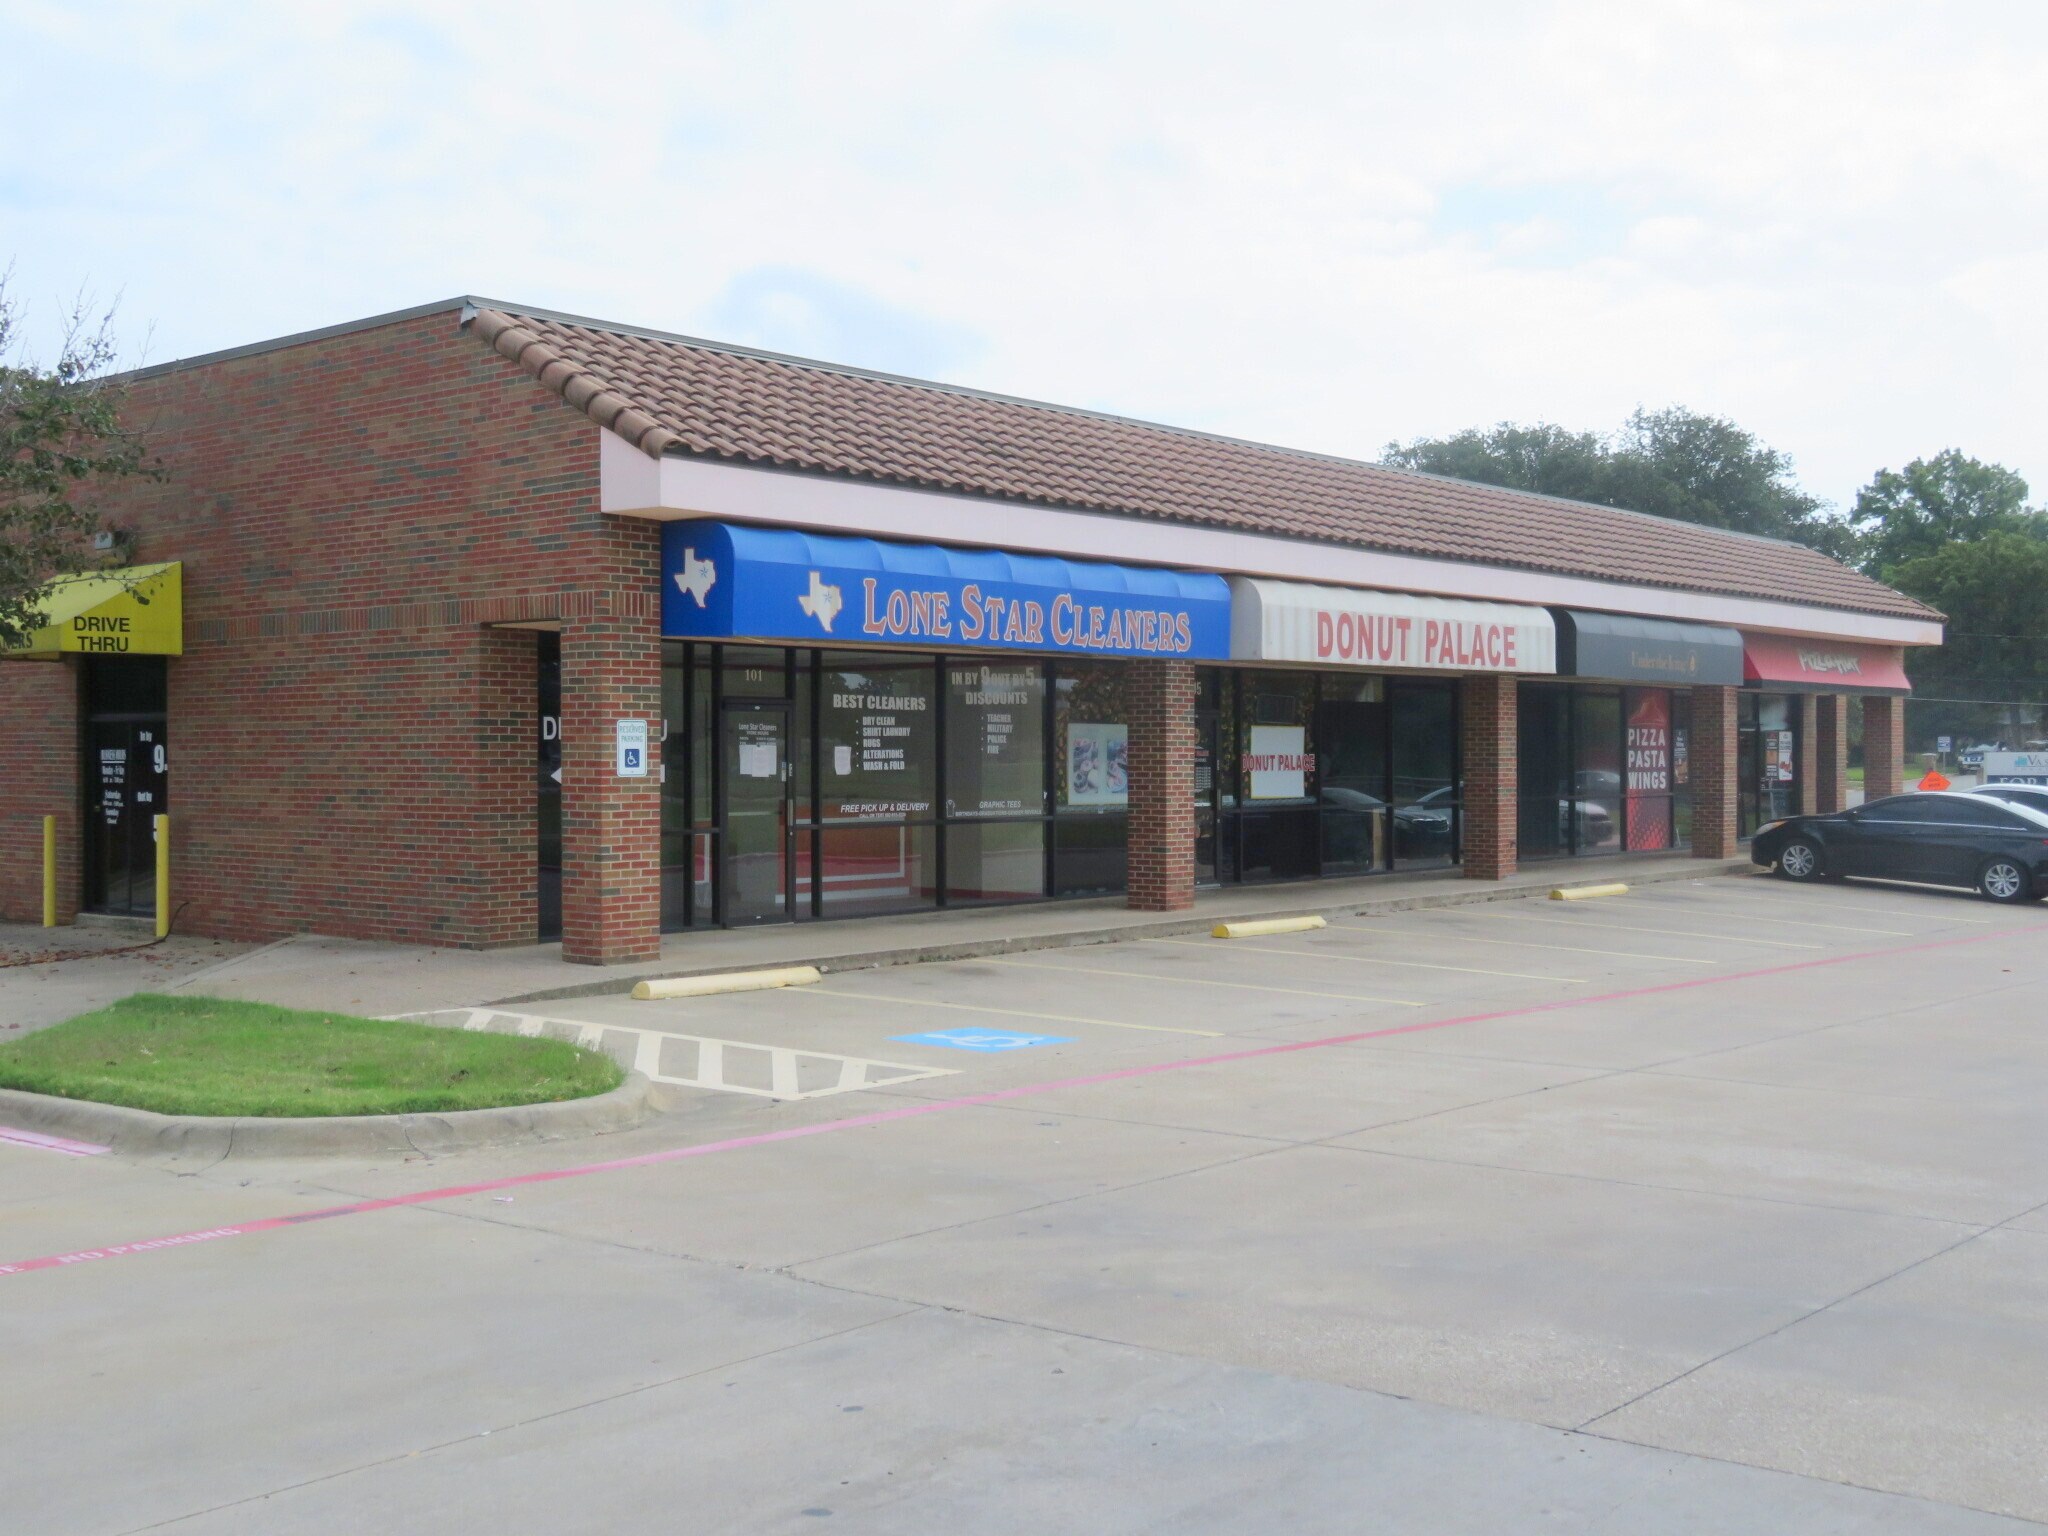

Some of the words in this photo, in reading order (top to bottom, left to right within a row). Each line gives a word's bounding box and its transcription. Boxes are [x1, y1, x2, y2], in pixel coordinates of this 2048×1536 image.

[74, 616, 130, 632] DRIVE
[77, 636, 129, 652] THRU
[1317, 611, 1411, 662] DONUT
[1425, 620, 1517, 667] PALACE
[745, 669, 762, 681] 101
[952, 672, 962, 685] IN
[965, 672, 978, 685] BY
[833, 694, 864, 709] BEST
[867, 695, 926, 711] CLEANERS
[965, 692, 1028, 705] DISCOUNTS
[876, 716, 896, 726] CLEAN
[619, 725, 645, 734] RESERVED
[862, 727, 882, 737] SHIRT
[883, 727, 911, 737] LAUNDRY
[987, 724, 1013, 733] MILITARY
[621, 735, 644, 743] PARKING
[863, 738, 881, 748] RUGS
[987, 735, 1007, 744] POLICE
[1628, 728, 1666, 746] PIZZA
[863, 749, 904, 760] ALTERATIONS
[1628, 750, 1666, 767] PASTA
[863, 761, 883, 771] WASH
[889, 761, 905, 771] FOLD
[1241, 754, 1275, 772] DONUT
[1278, 754, 1315, 772] PALACE
[1628, 772, 1666, 790] WINGS
[840, 804, 859, 813] FREE
[860, 803, 878, 813] PICK
[879, 803, 889, 812] UP
[889, 803, 895, 812] &
[896, 802, 929, 811] DELIVERY
[979, 801, 1005, 809] GRAPHIC
[58, 1250, 104, 1264] NO
[107, 1228, 243, 1254] PARKING
